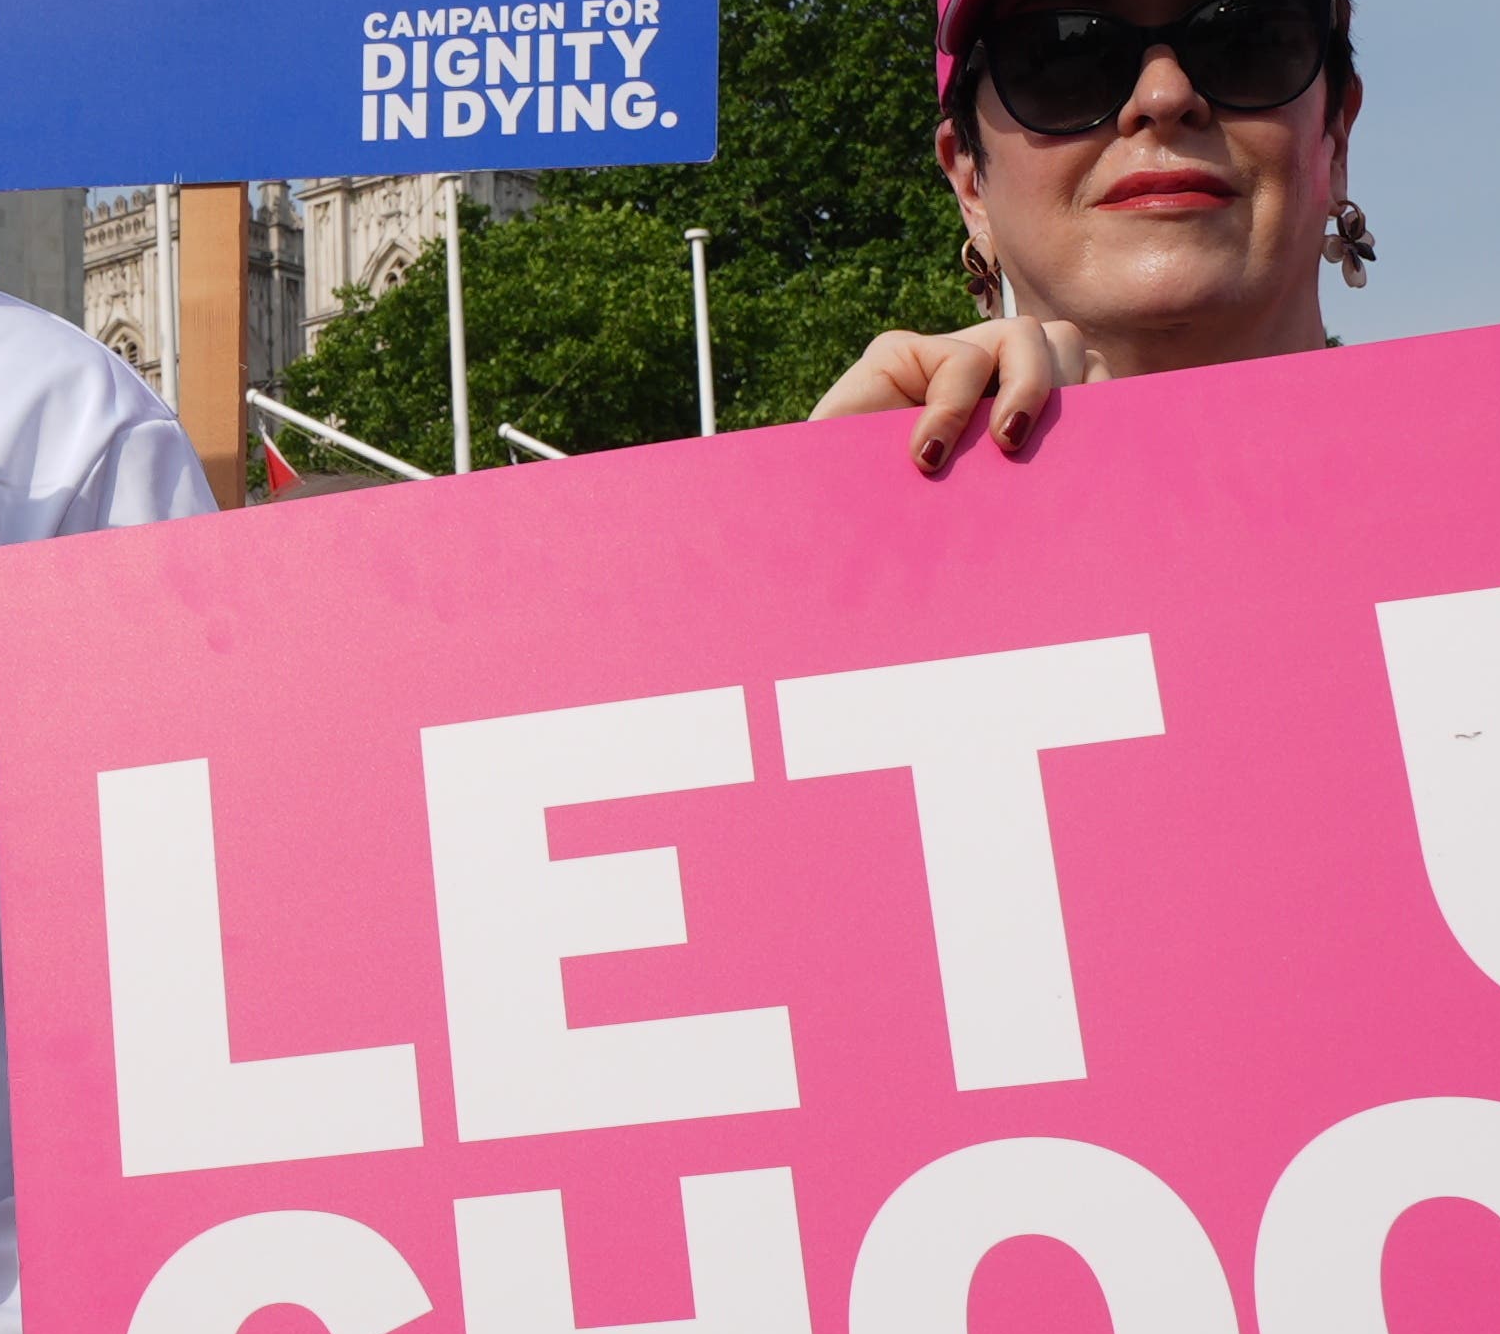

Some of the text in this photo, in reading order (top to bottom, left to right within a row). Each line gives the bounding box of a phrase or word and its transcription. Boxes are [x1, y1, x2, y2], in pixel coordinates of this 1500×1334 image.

[363, 2, 565, 39] CAMPAIGN
[362, 28, 659, 92] DIGNITY
[362, 81, 679, 141] IN DYING.
[97, 633, 1166, 1177] LET
